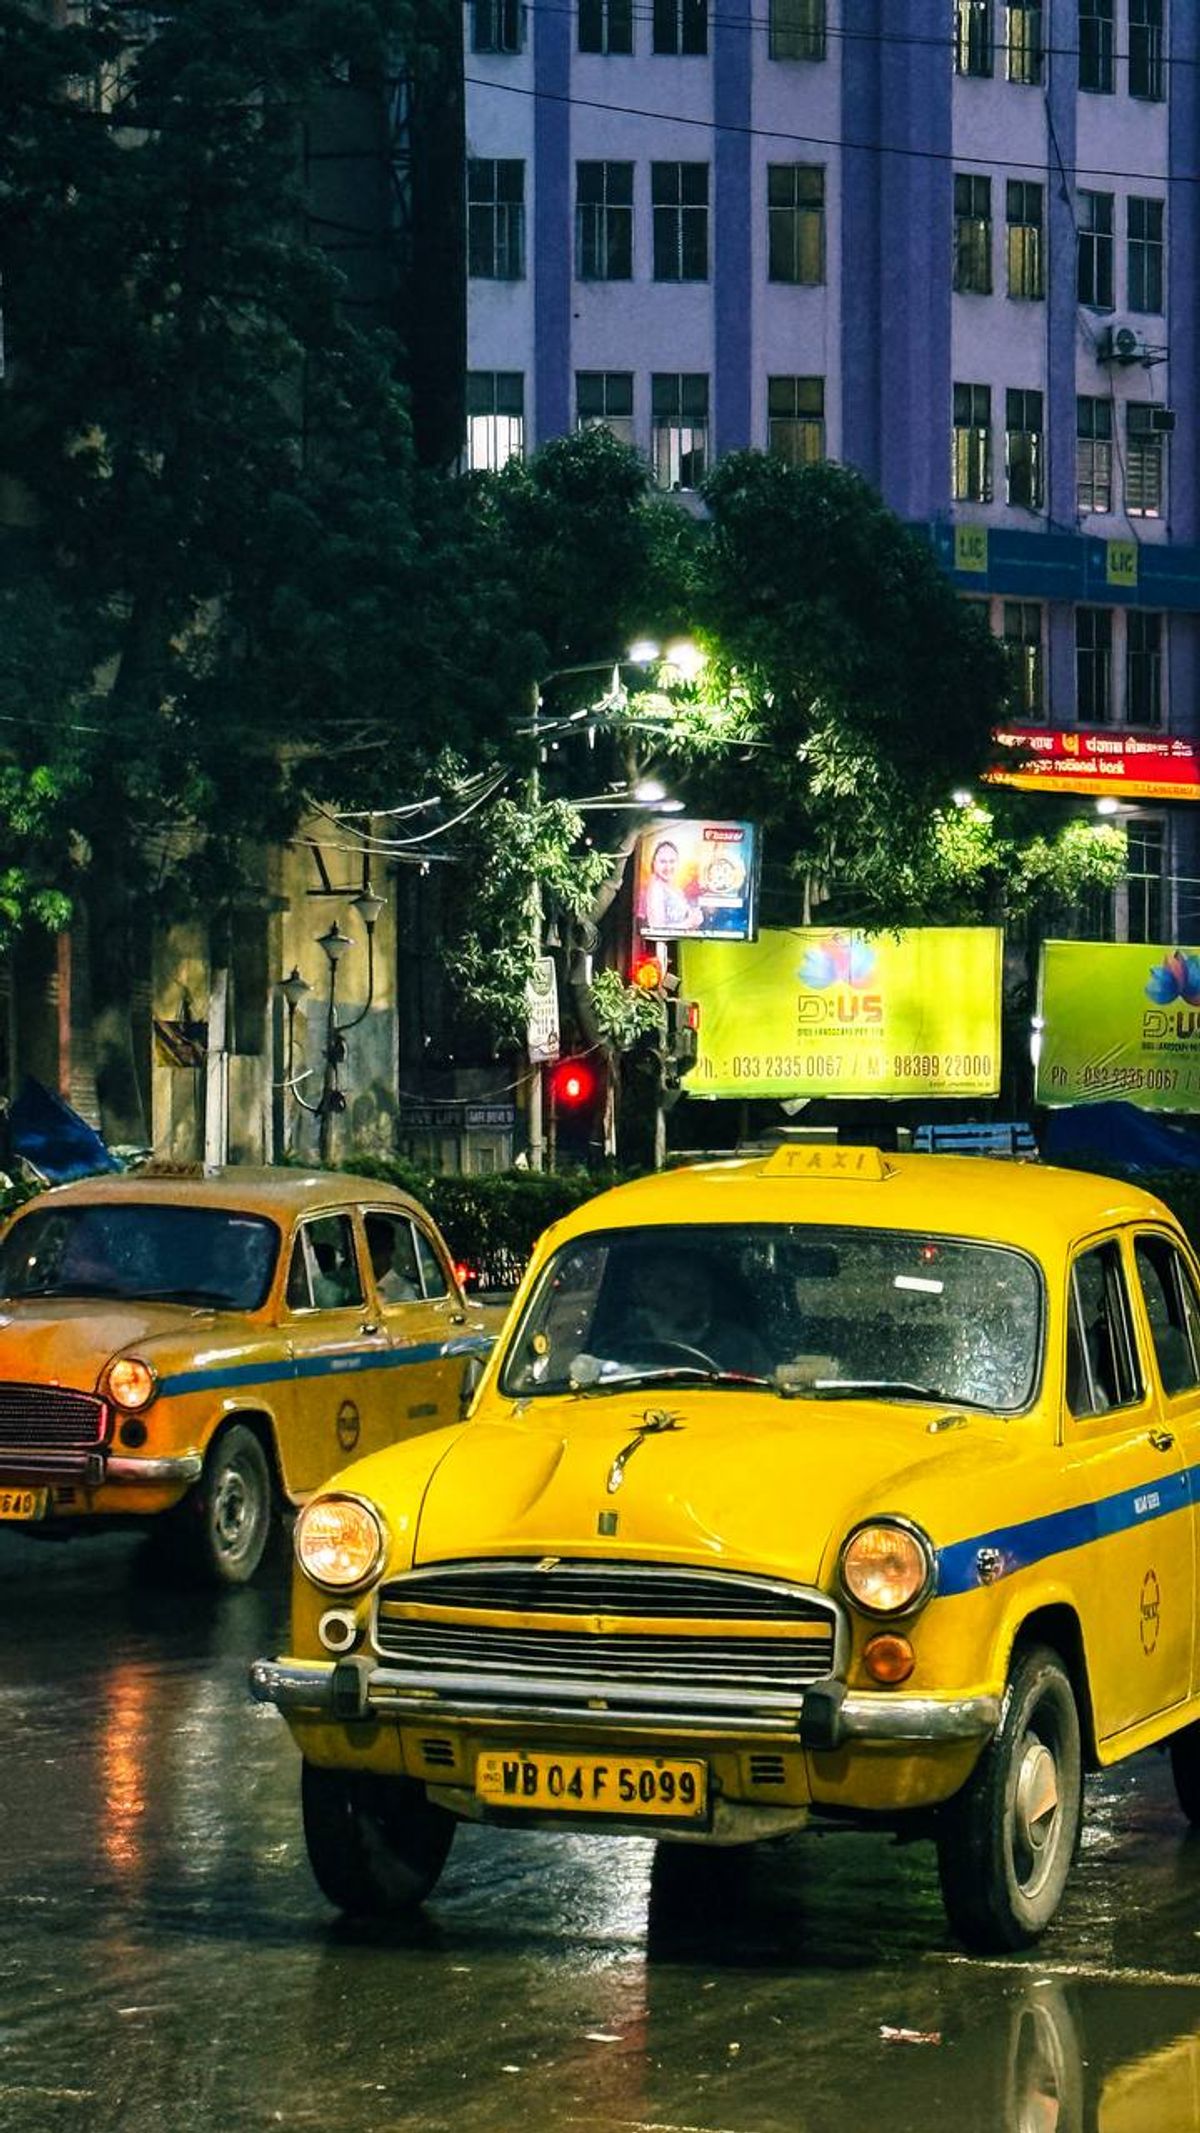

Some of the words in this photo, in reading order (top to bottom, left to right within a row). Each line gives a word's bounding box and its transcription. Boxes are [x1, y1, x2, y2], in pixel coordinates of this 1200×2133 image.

[1111, 551, 1133, 572] LIC
[733, 1056, 760, 1078] 033
[766, 1056, 801, 1078] 2335
[807, 1056, 842, 1077] 0067
[945, 1055, 991, 1077] 22000
[1147, 1068, 1179, 1090] 0067
[786, 1151, 866, 1170] TAXI
[503, 1761, 539, 1796] WB
[547, 1765, 584, 1799] 04
[593, 1766, 608, 1800] F
[618, 1768, 696, 1804] 5099
